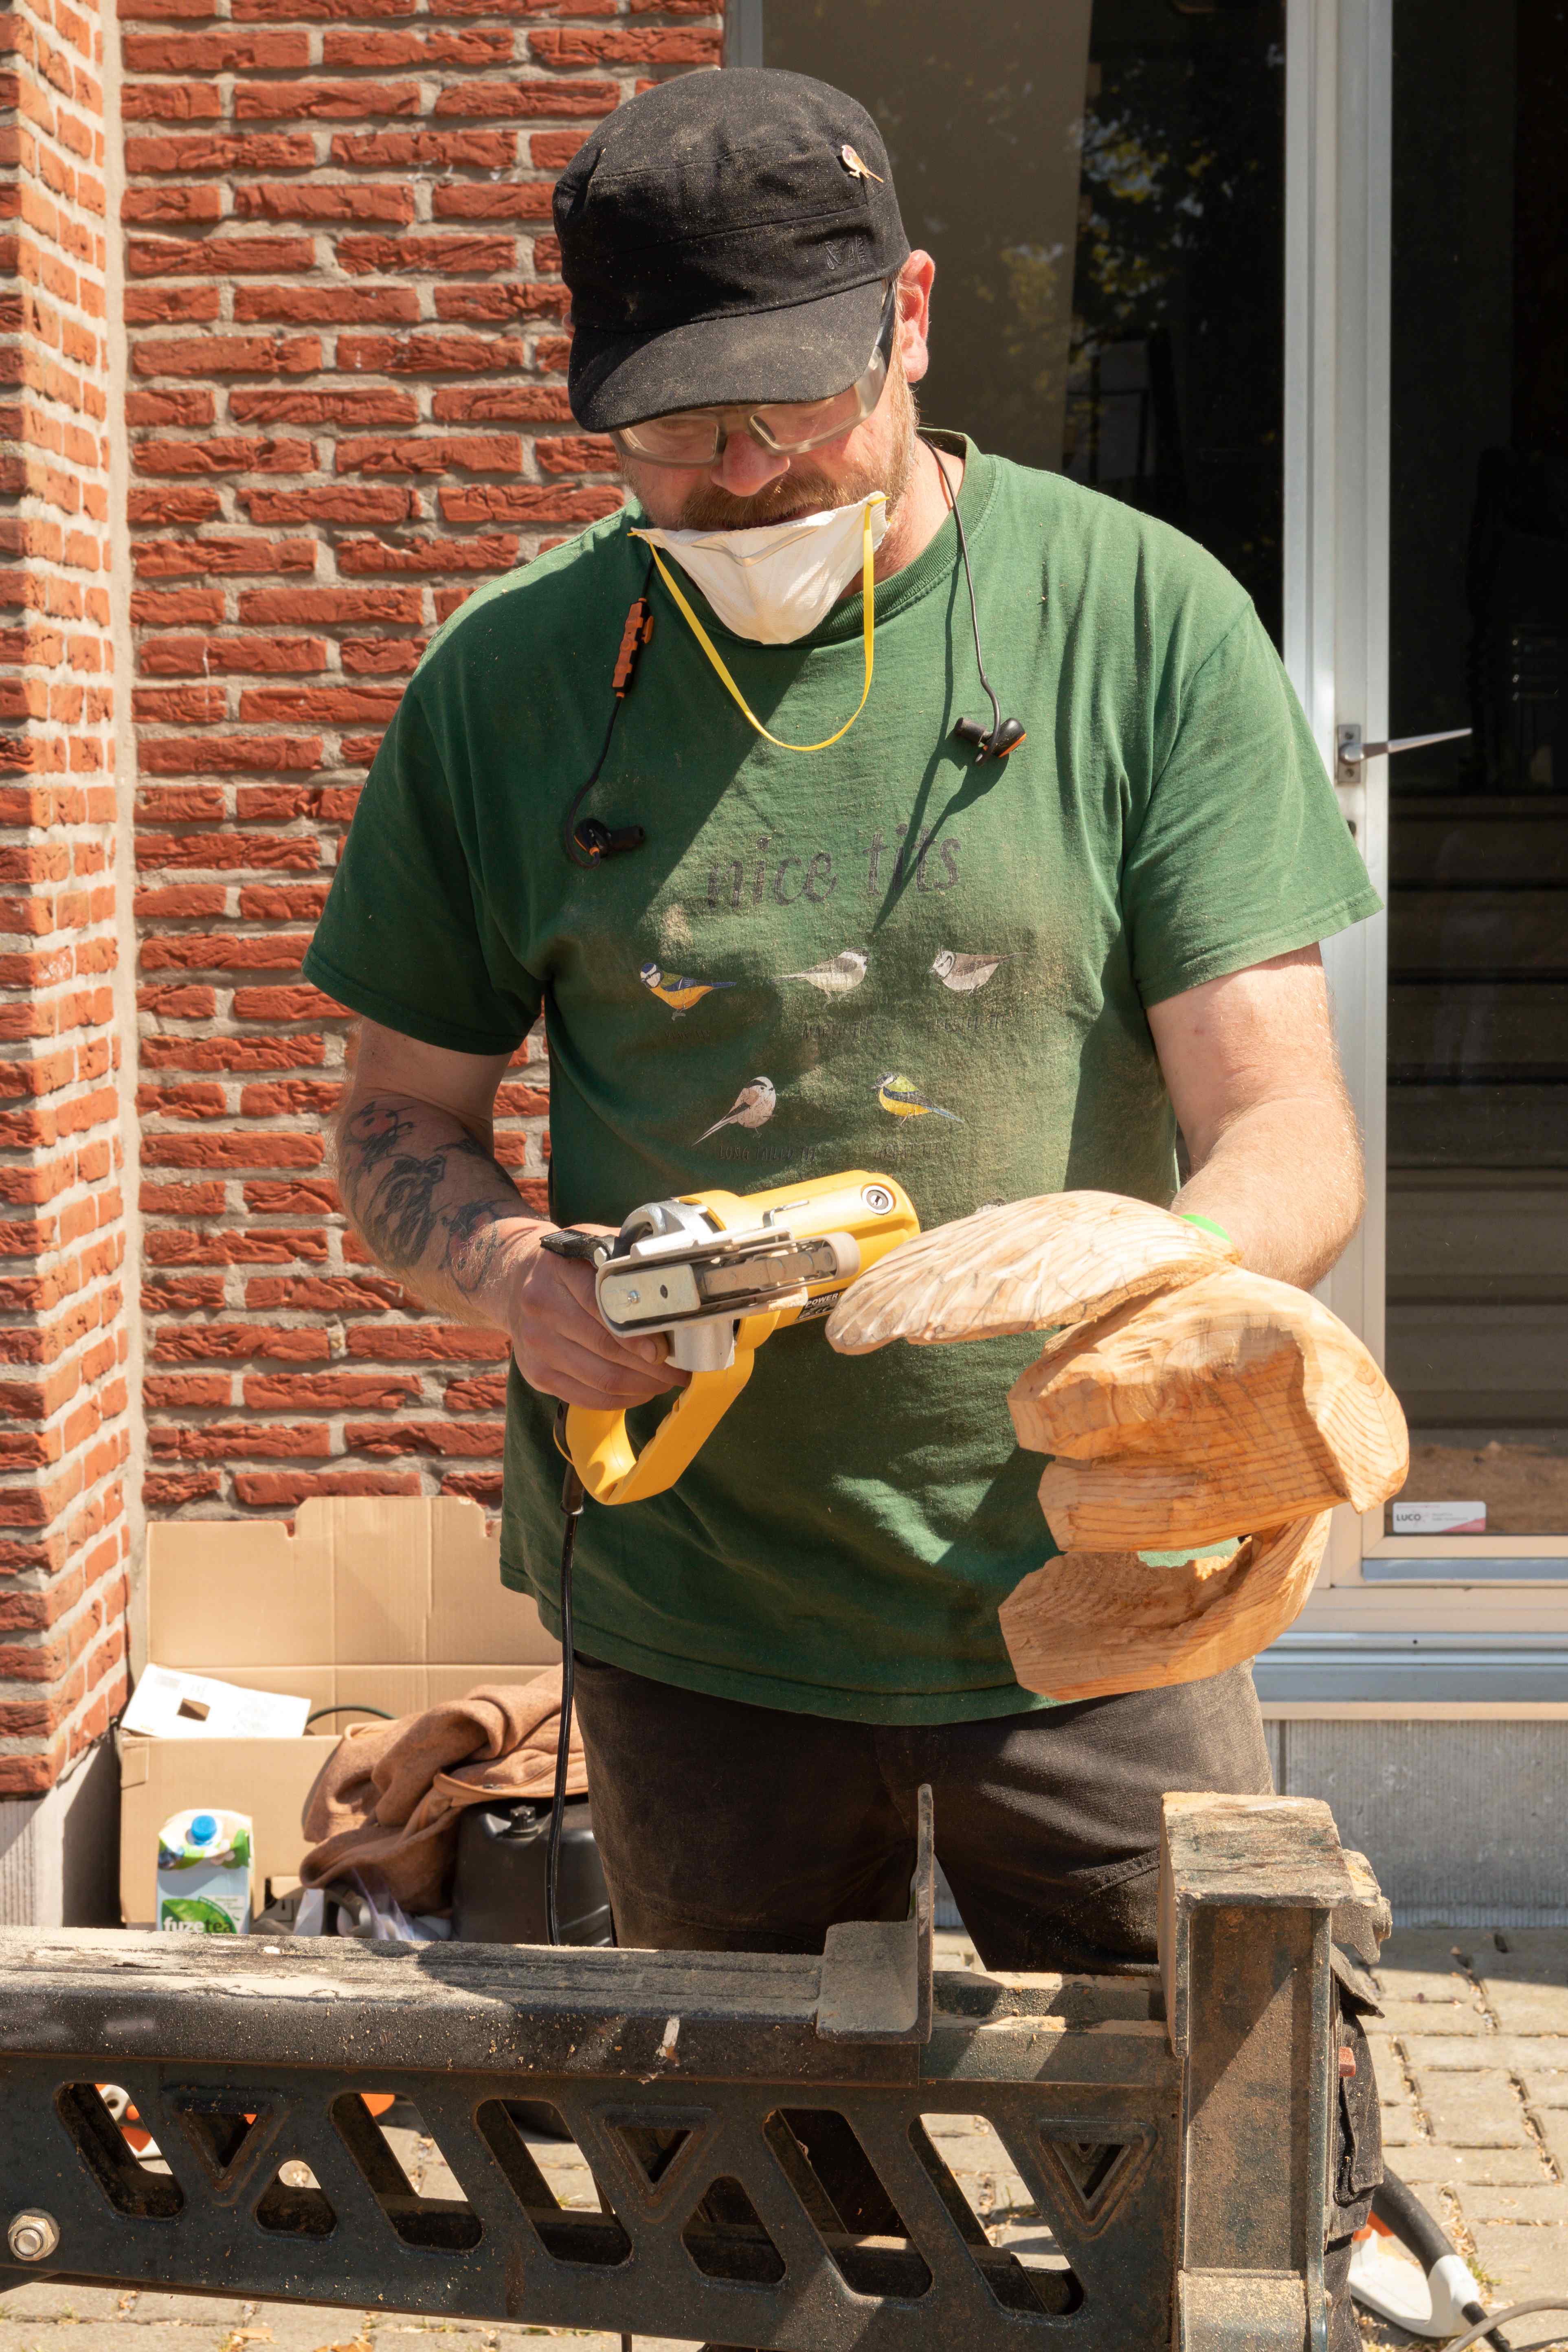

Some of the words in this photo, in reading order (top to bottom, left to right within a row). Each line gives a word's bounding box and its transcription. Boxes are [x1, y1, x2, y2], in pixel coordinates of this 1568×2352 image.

[707, 836, 838, 908] nice
[863, 823, 962, 896] tits
[720, 1146, 750, 1161] LONG
[1396, 1513, 1421, 1522] LUCO
